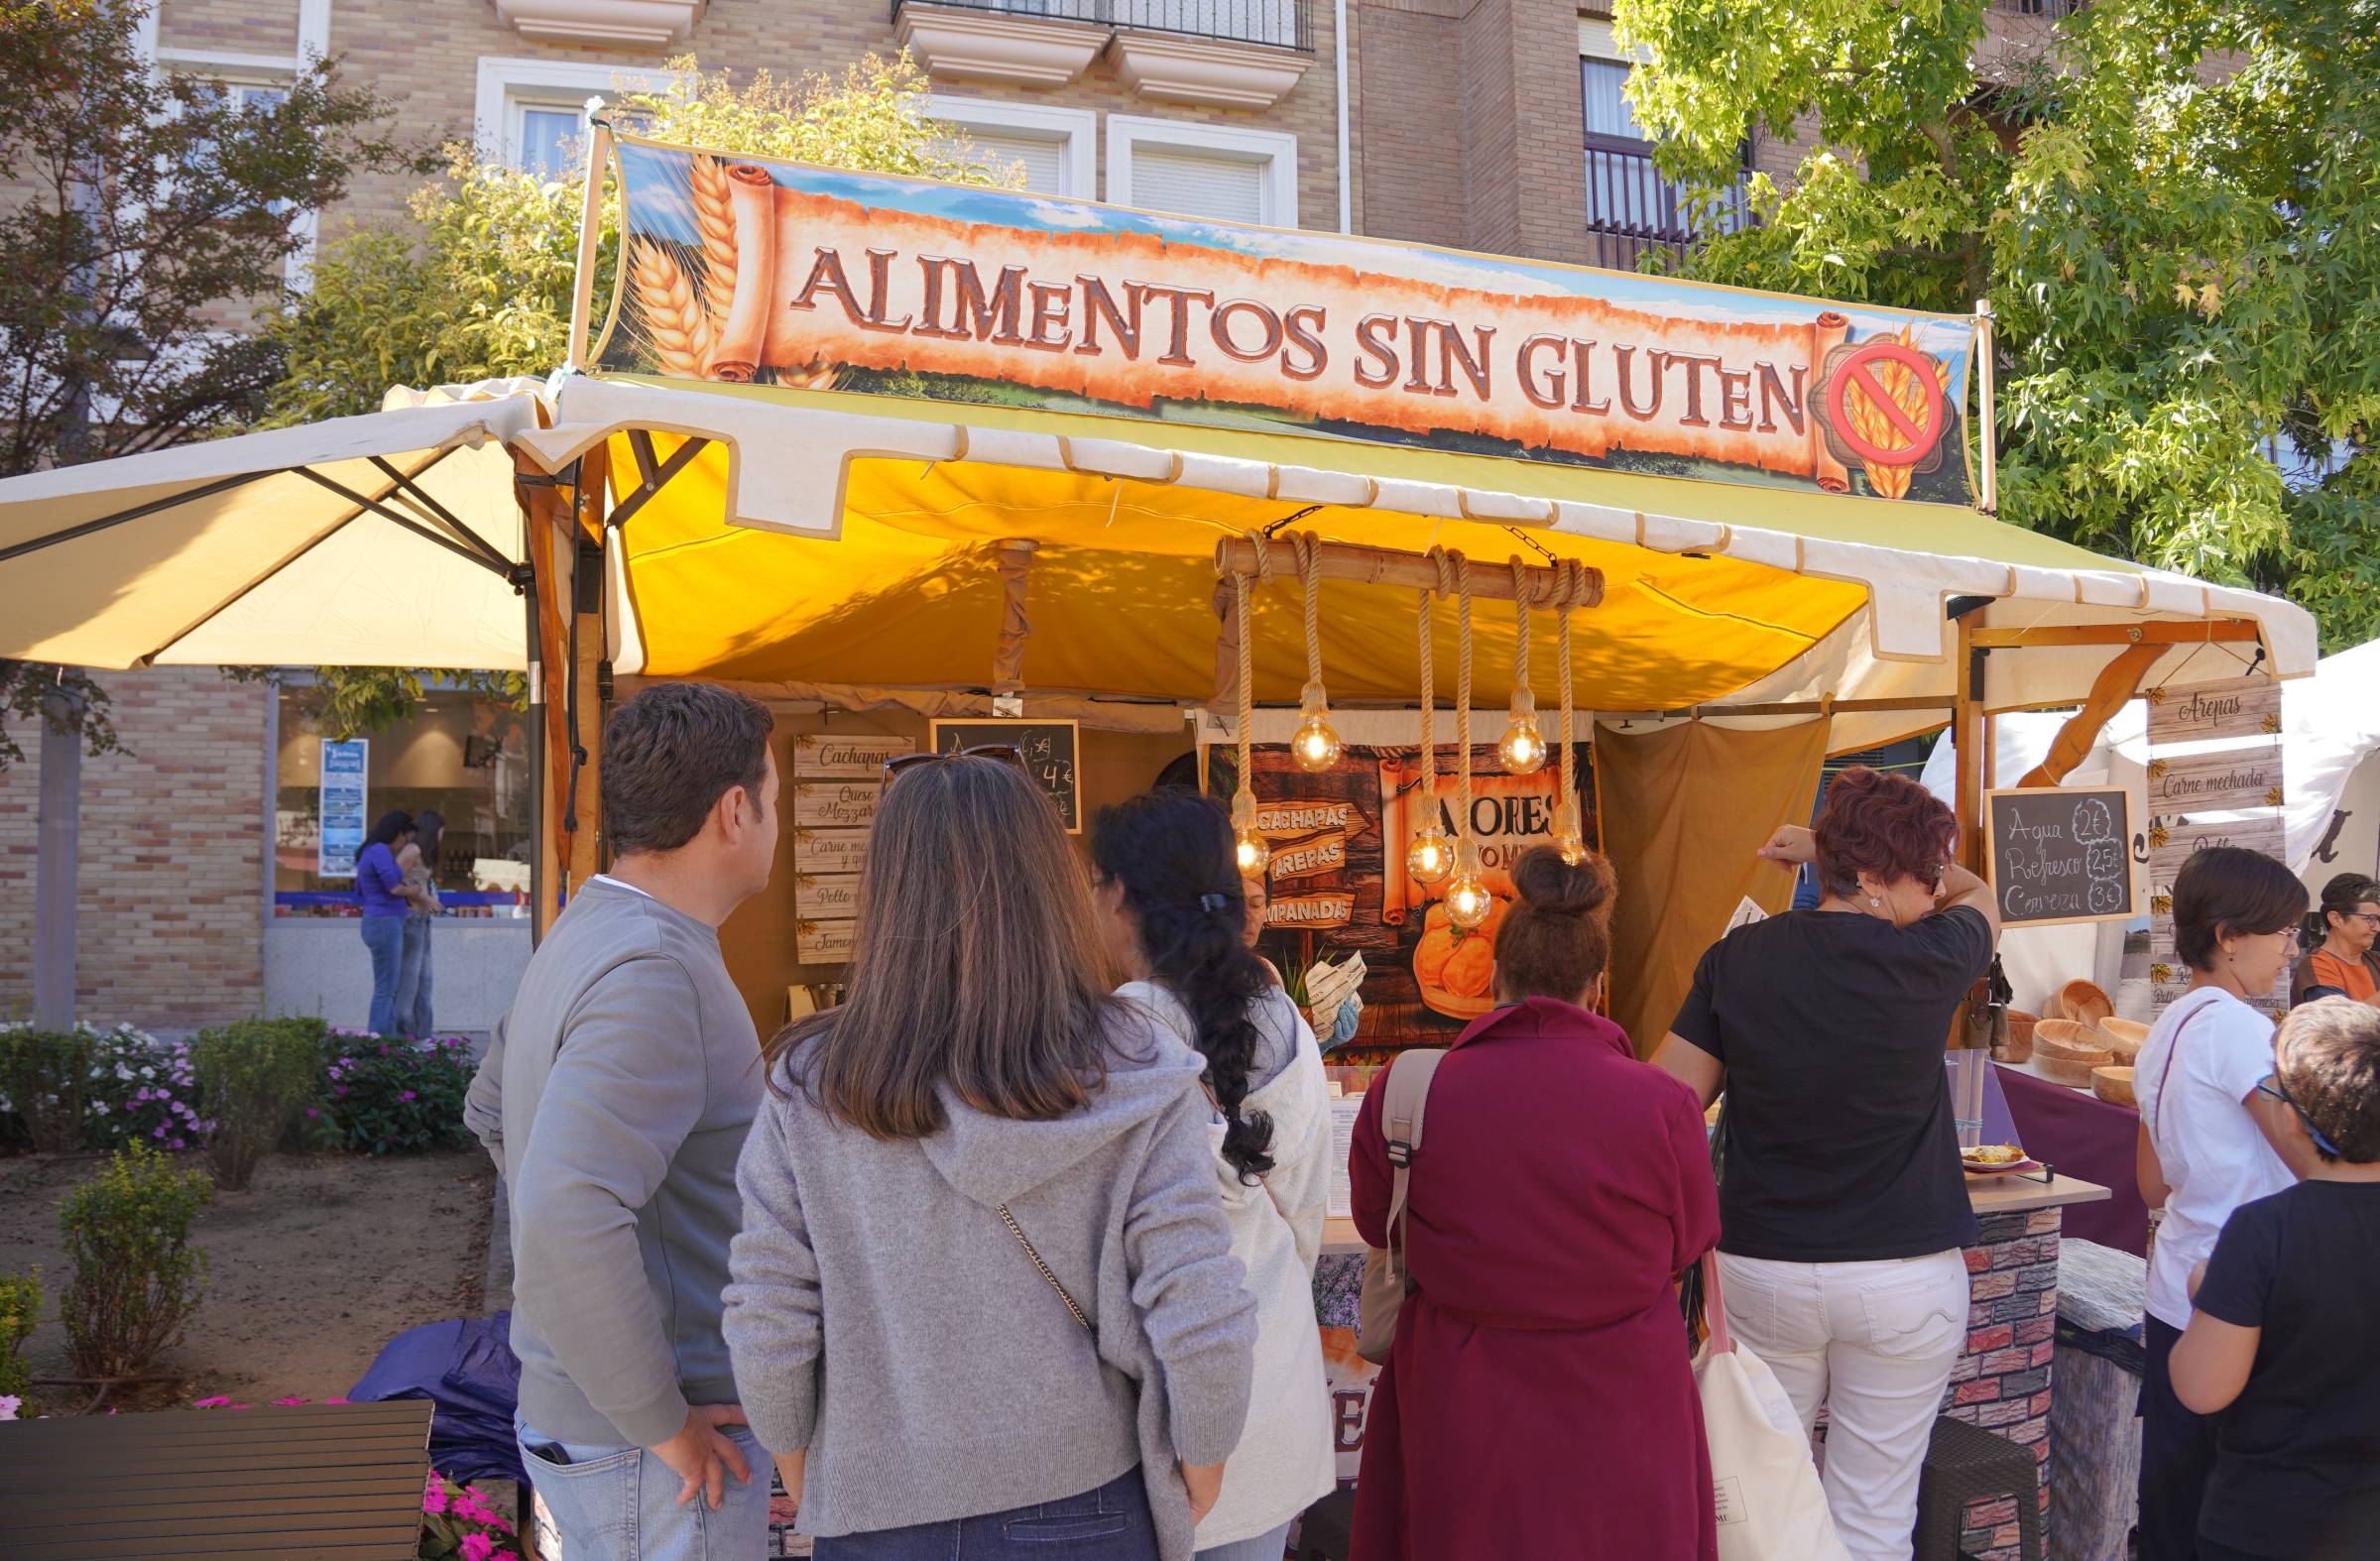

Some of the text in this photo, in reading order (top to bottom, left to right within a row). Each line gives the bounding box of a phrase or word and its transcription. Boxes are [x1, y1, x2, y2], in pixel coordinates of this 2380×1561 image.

[789, 245, 1808, 437] ALIMENTOS SIN GLUTEN
[2178, 691, 2241, 728] Arepas
[839, 785, 873, 803] Queso
[2163, 767, 2265, 798] Carne mechada
[818, 801, 874, 823] Mozzar
[1256, 807, 1348, 831] CACHAPAS
[2008, 806, 2064, 854] Agua
[1274, 842, 1340, 878] AREPAS
[2005, 847, 2082, 887] Refresco
[816, 888, 850, 904] Pollo
[1264, 900, 1347, 922] MPANADAS
[2004, 885, 2082, 916] Cerveza
